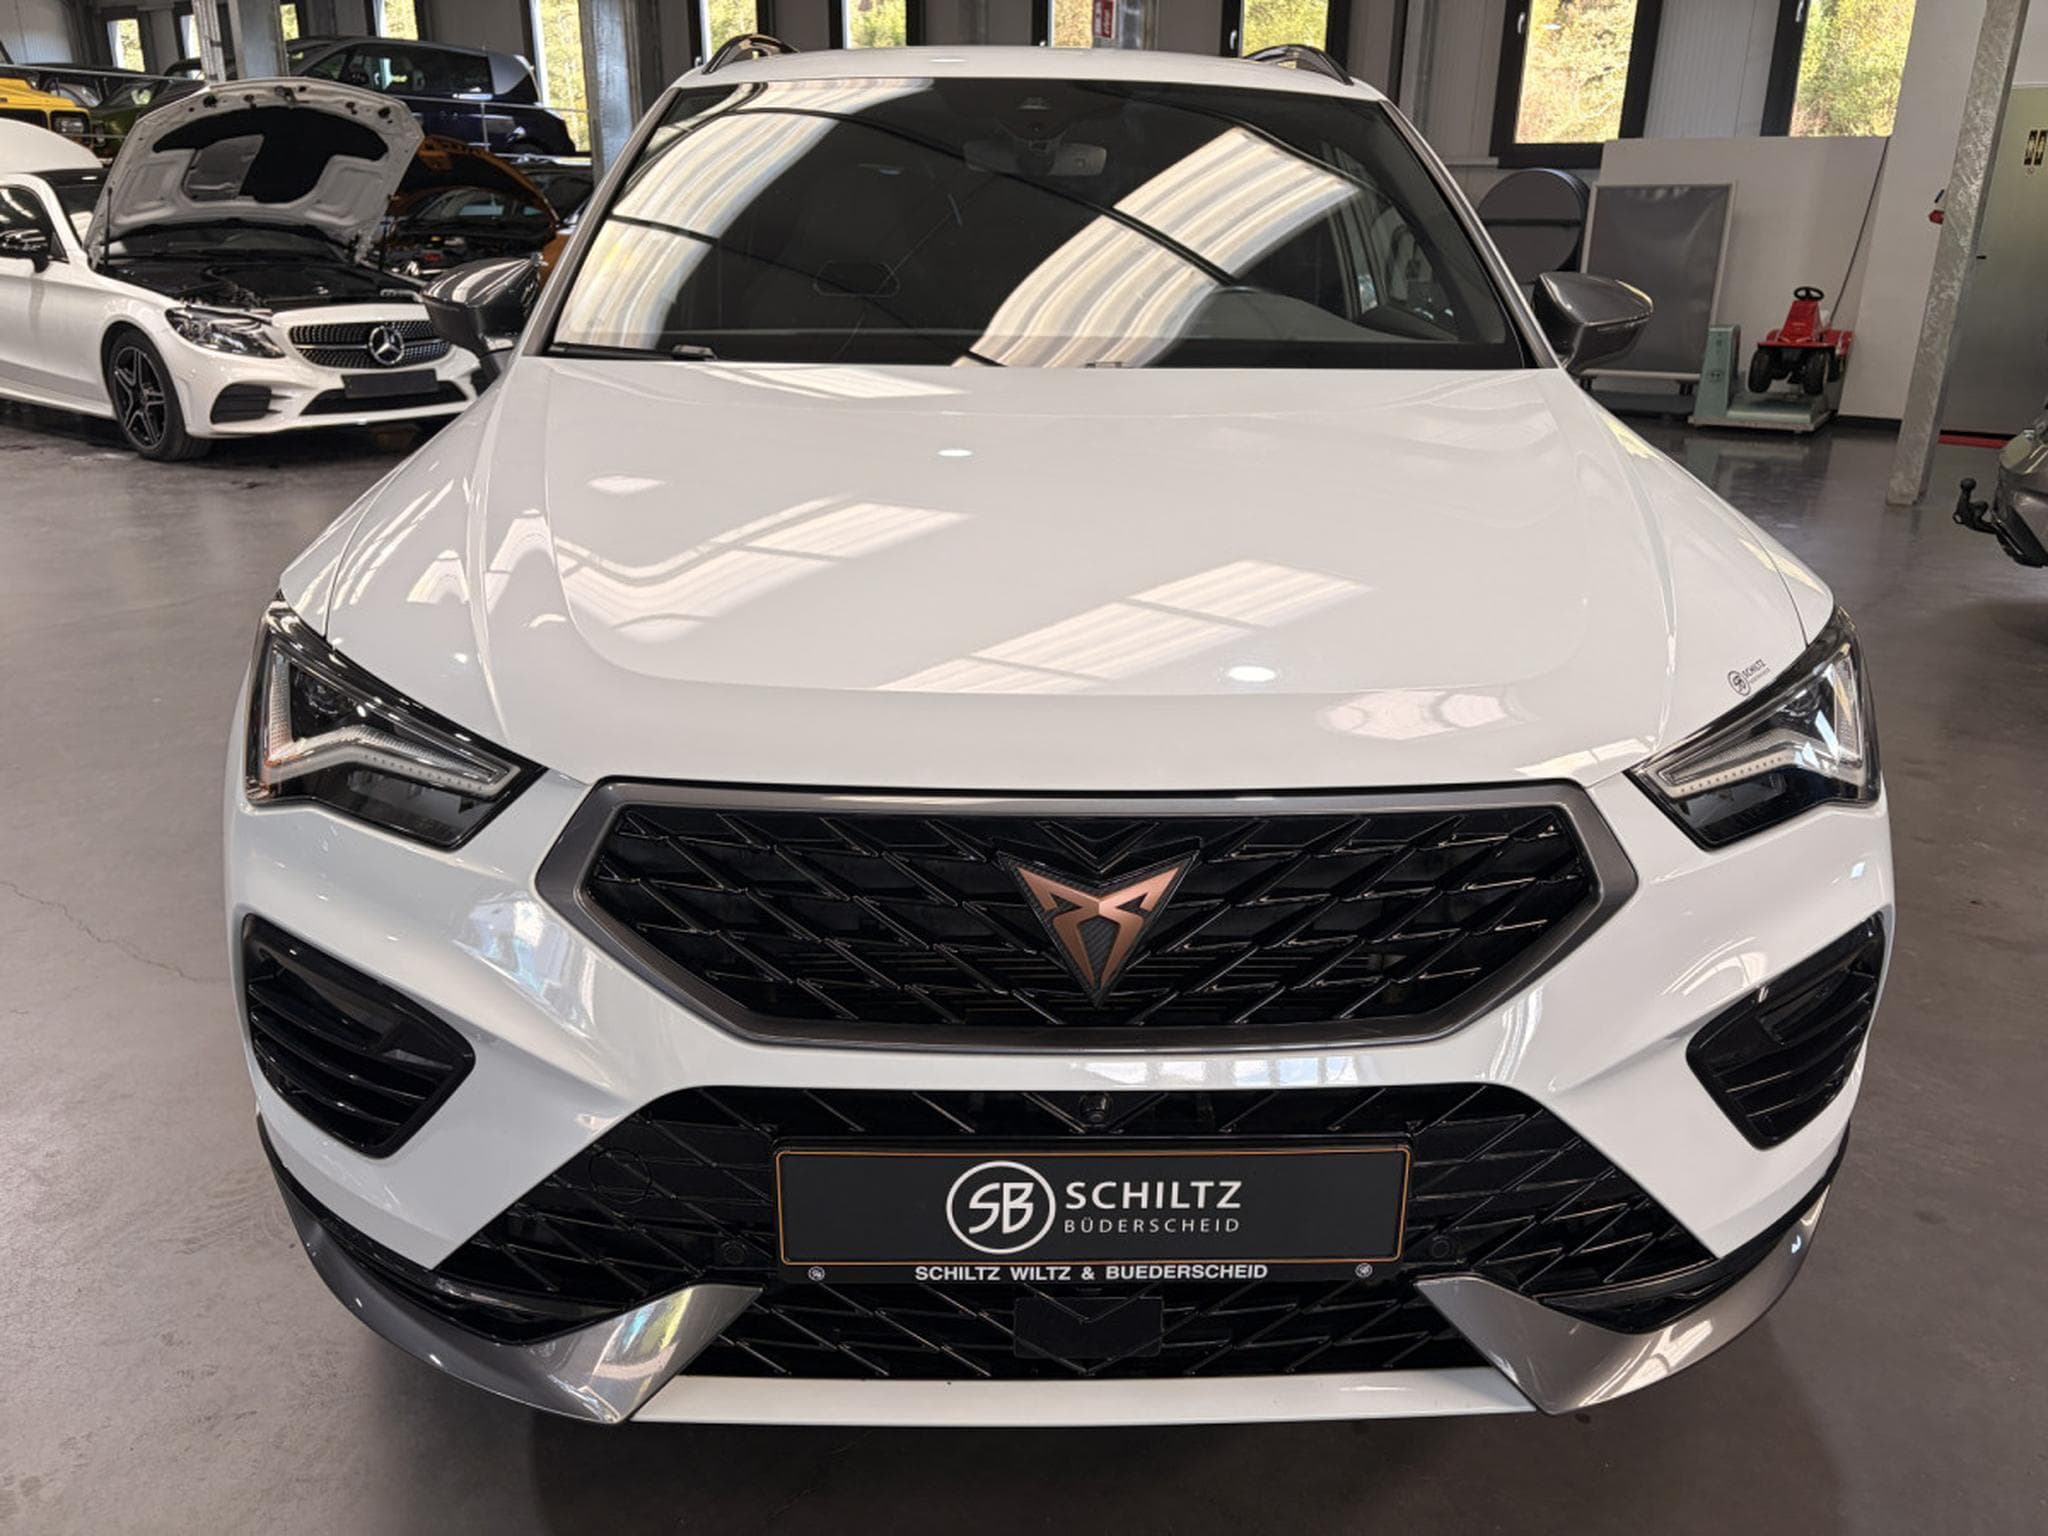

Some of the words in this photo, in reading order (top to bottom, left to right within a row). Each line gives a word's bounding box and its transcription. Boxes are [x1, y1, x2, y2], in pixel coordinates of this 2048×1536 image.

[1064, 1180, 1243, 1210] SCHILTZ
[1063, 1216, 1240, 1234] BÜDERSCHEID
[914, 1265, 1001, 1282] SCHILTZ
[1009, 1265, 1072, 1281] WILTZ
[1080, 1266, 1096, 1281] &
[1104, 1264, 1269, 1281] BUEDERSCHEID
